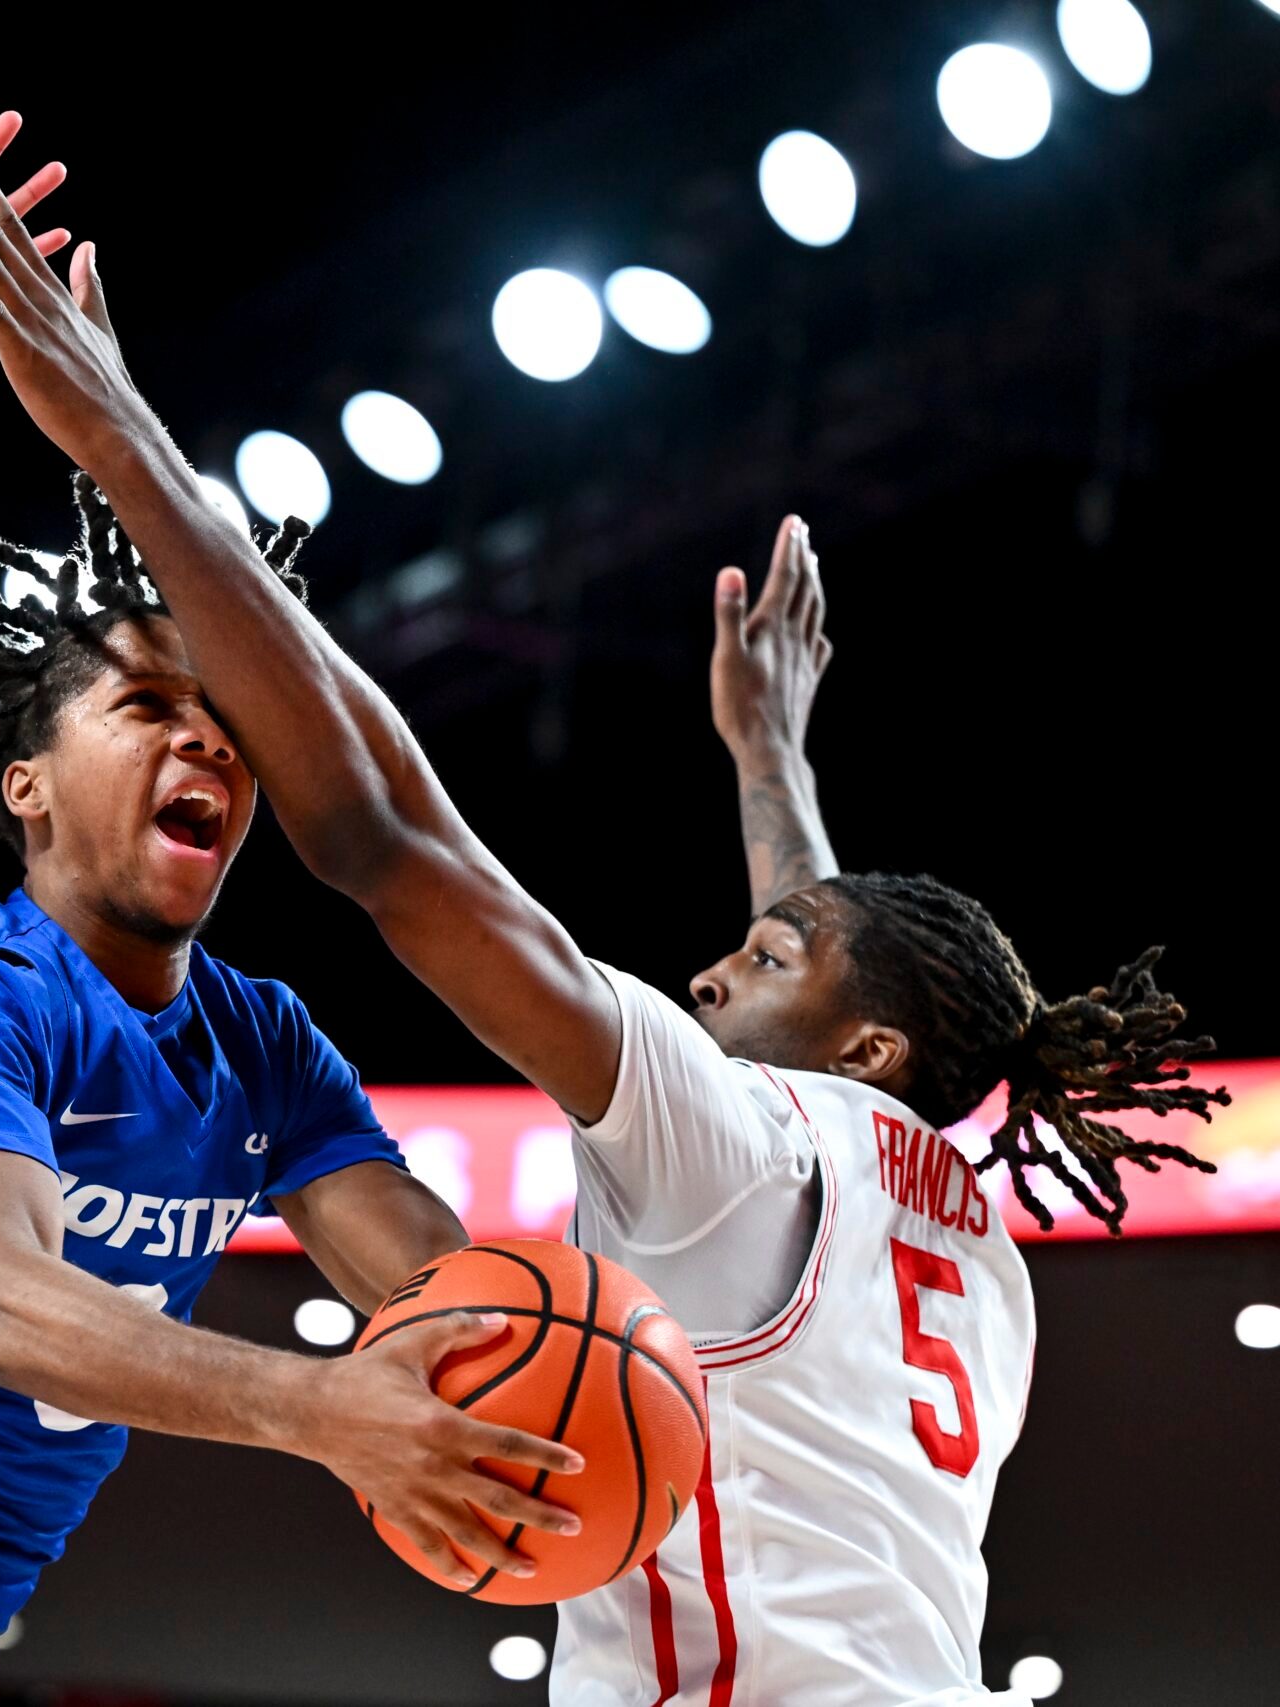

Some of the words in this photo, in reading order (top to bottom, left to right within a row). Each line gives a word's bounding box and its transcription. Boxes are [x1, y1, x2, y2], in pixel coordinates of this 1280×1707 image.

[60, 1170, 260, 1258] OFSTR
[872, 1110, 989, 1238] FRANCIS
[889, 1236, 981, 1479] 5
